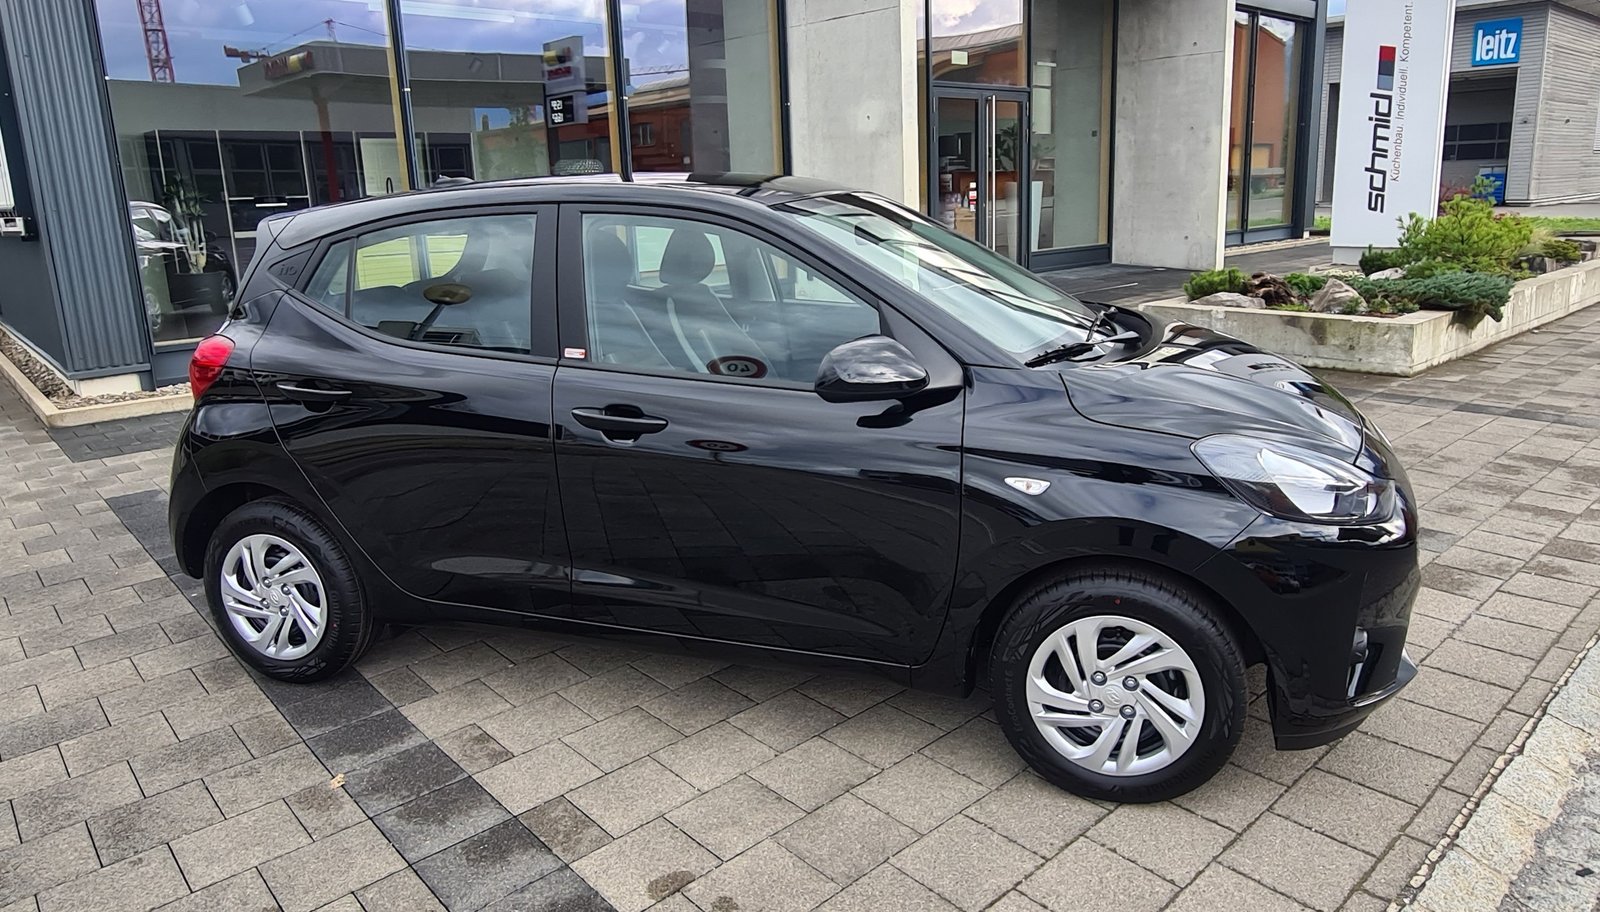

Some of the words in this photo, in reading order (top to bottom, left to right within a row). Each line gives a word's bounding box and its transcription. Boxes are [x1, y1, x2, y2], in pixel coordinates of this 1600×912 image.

[1400, 1, 1413, 62] Kompetent.
[1475, 29, 1517, 61] leitz
[1394, 66, 1409, 120] Individuell.
[1364, 92, 1393, 213] schmid
[1390, 123, 1404, 182] Küchenbau.
